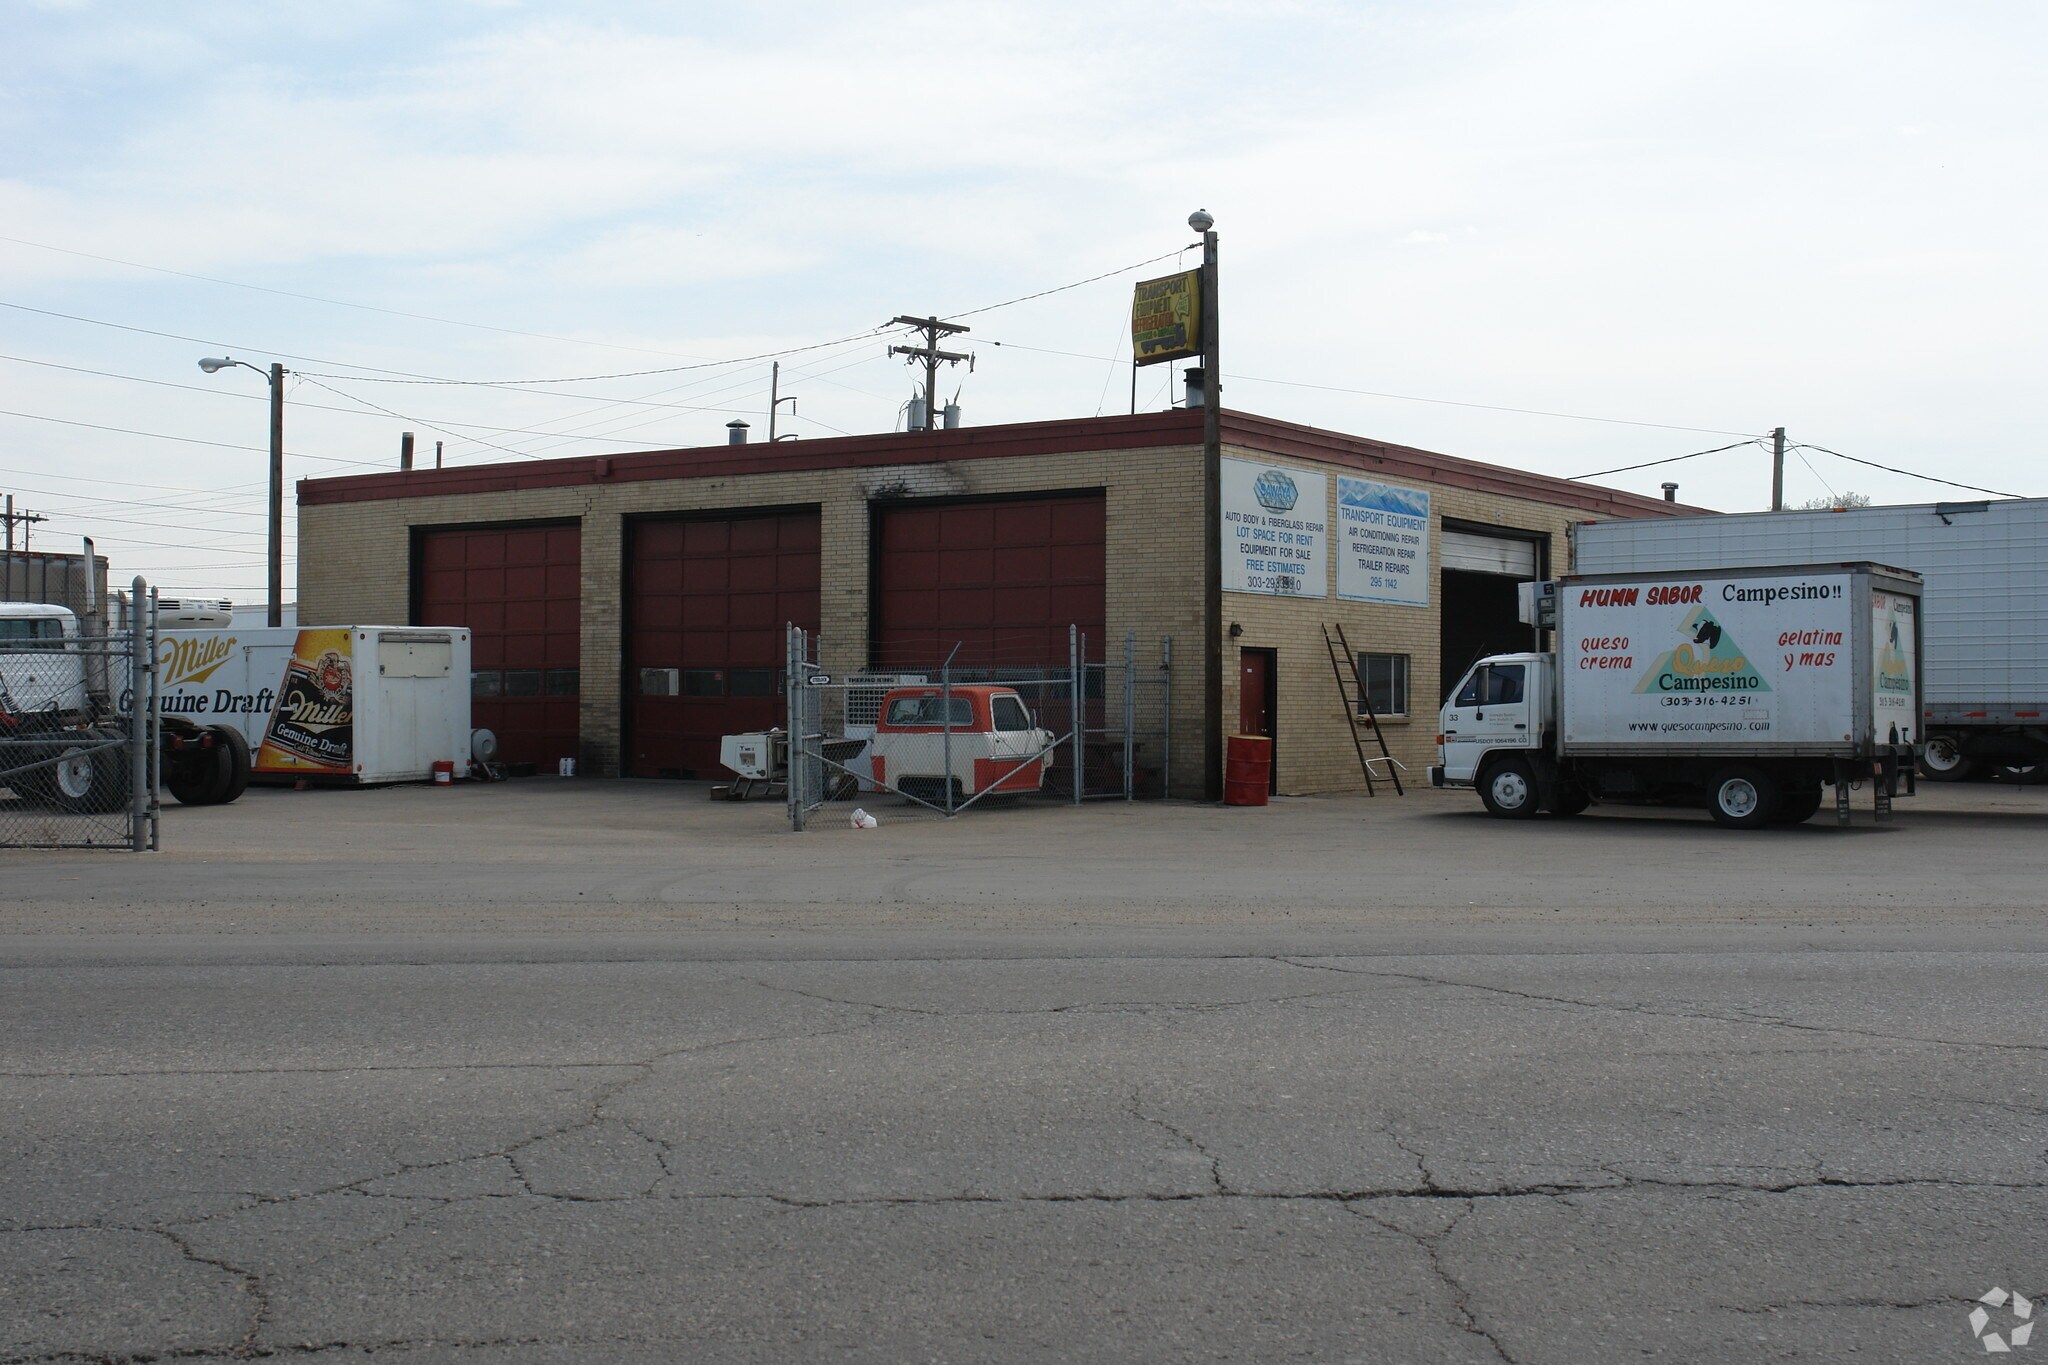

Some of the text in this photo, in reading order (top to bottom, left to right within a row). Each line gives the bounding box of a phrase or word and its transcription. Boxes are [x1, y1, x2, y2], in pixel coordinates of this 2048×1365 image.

[1225, 512, 1324, 532] AUTO BODY & FIBERGLASS REPAIR
[1341, 508, 1426, 531] TRANSPORT EQUIPMENT
[1237, 526, 1313, 546] LOT SPACE FOR RENT
[1349, 527, 1419, 545] AIR CONDITIONING REPAIR
[1241, 543, 1311, 560] EQUIPMENT FOR SALE
[1353, 543, 1415, 560] REFRIGERATION REPAIR
[1247, 559, 1305, 574] FREE ESTIMATES
[1358, 559, 1409, 574] TRAILER REPAIRS
[1371, 576, 1397, 589] 295 1142
[1646, 585, 1702, 605] SABOR
[1778, 629, 1842, 646] Gelatina
[159, 635, 238, 683] Miller
[1580, 656, 1632, 670] crema
[1672, 643, 1746, 676] Queso
[1784, 652, 1835, 671] y mas
[1659, 672, 1758, 693] Campesino
[119, 688, 274, 713] Guine Draft
[288, 690, 352, 723] Miller
[277, 724, 318, 748] Genuine
[319, 738, 347, 757] Draft
